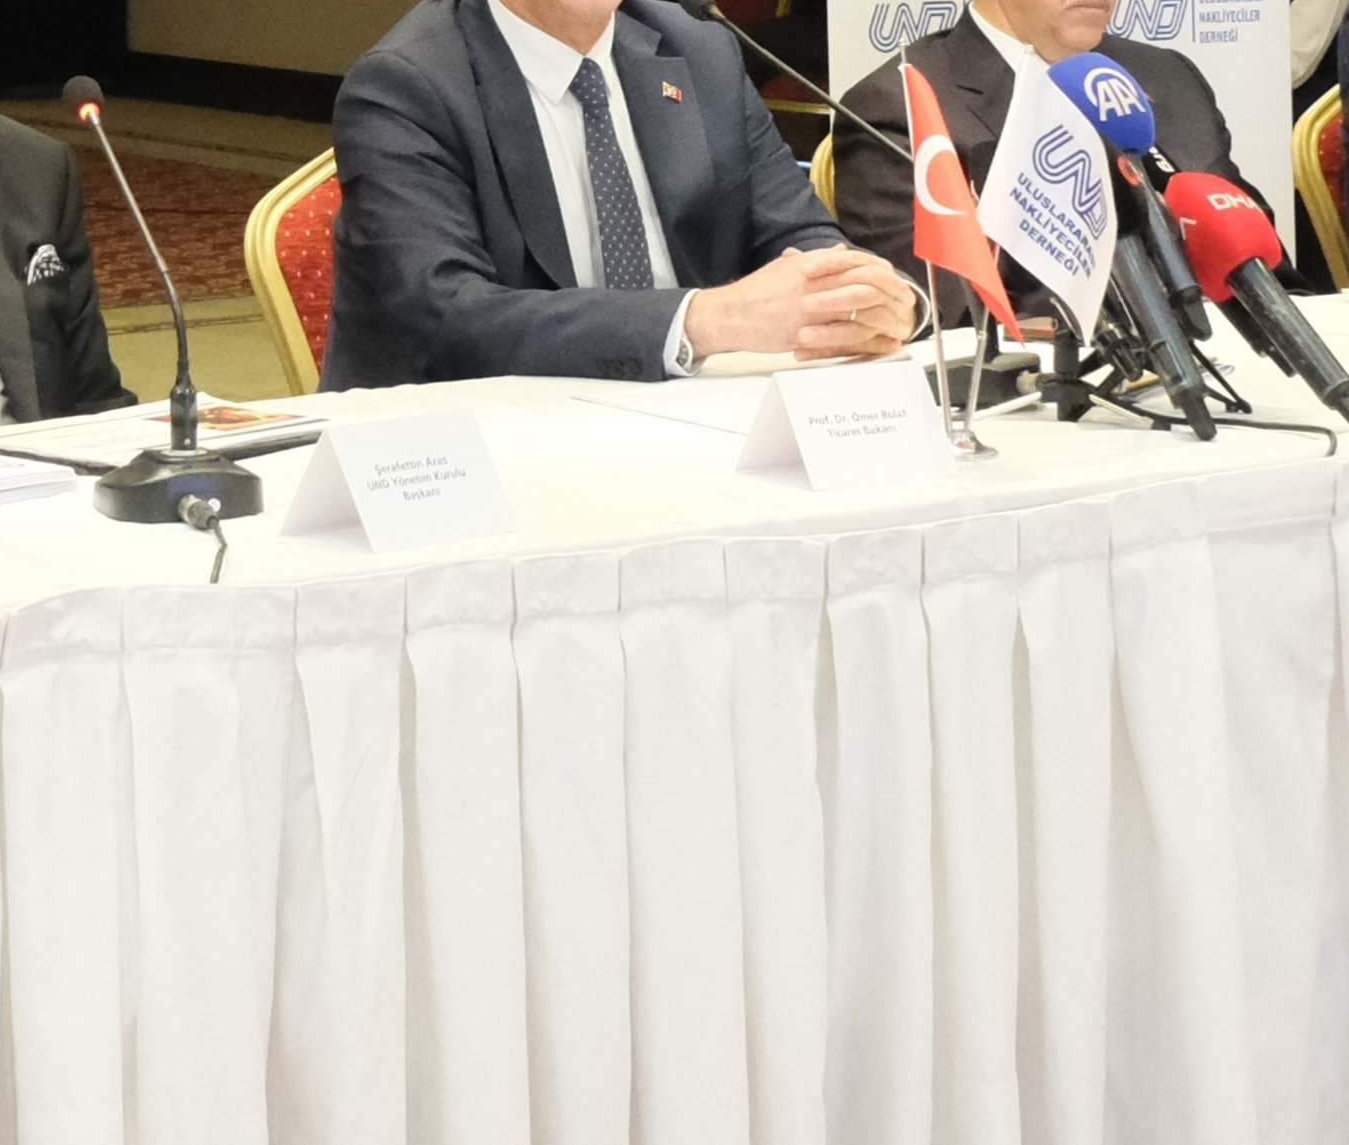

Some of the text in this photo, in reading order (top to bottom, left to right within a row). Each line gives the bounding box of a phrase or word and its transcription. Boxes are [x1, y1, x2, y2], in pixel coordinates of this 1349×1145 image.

[1097, 77, 1146, 121] AA
[1019, 218, 1080, 276] DERNEĞİ
[808, 414, 833, 426] Prof.
[834, 414, 850, 424] Dr.
[880, 408, 908, 420] Bolat
